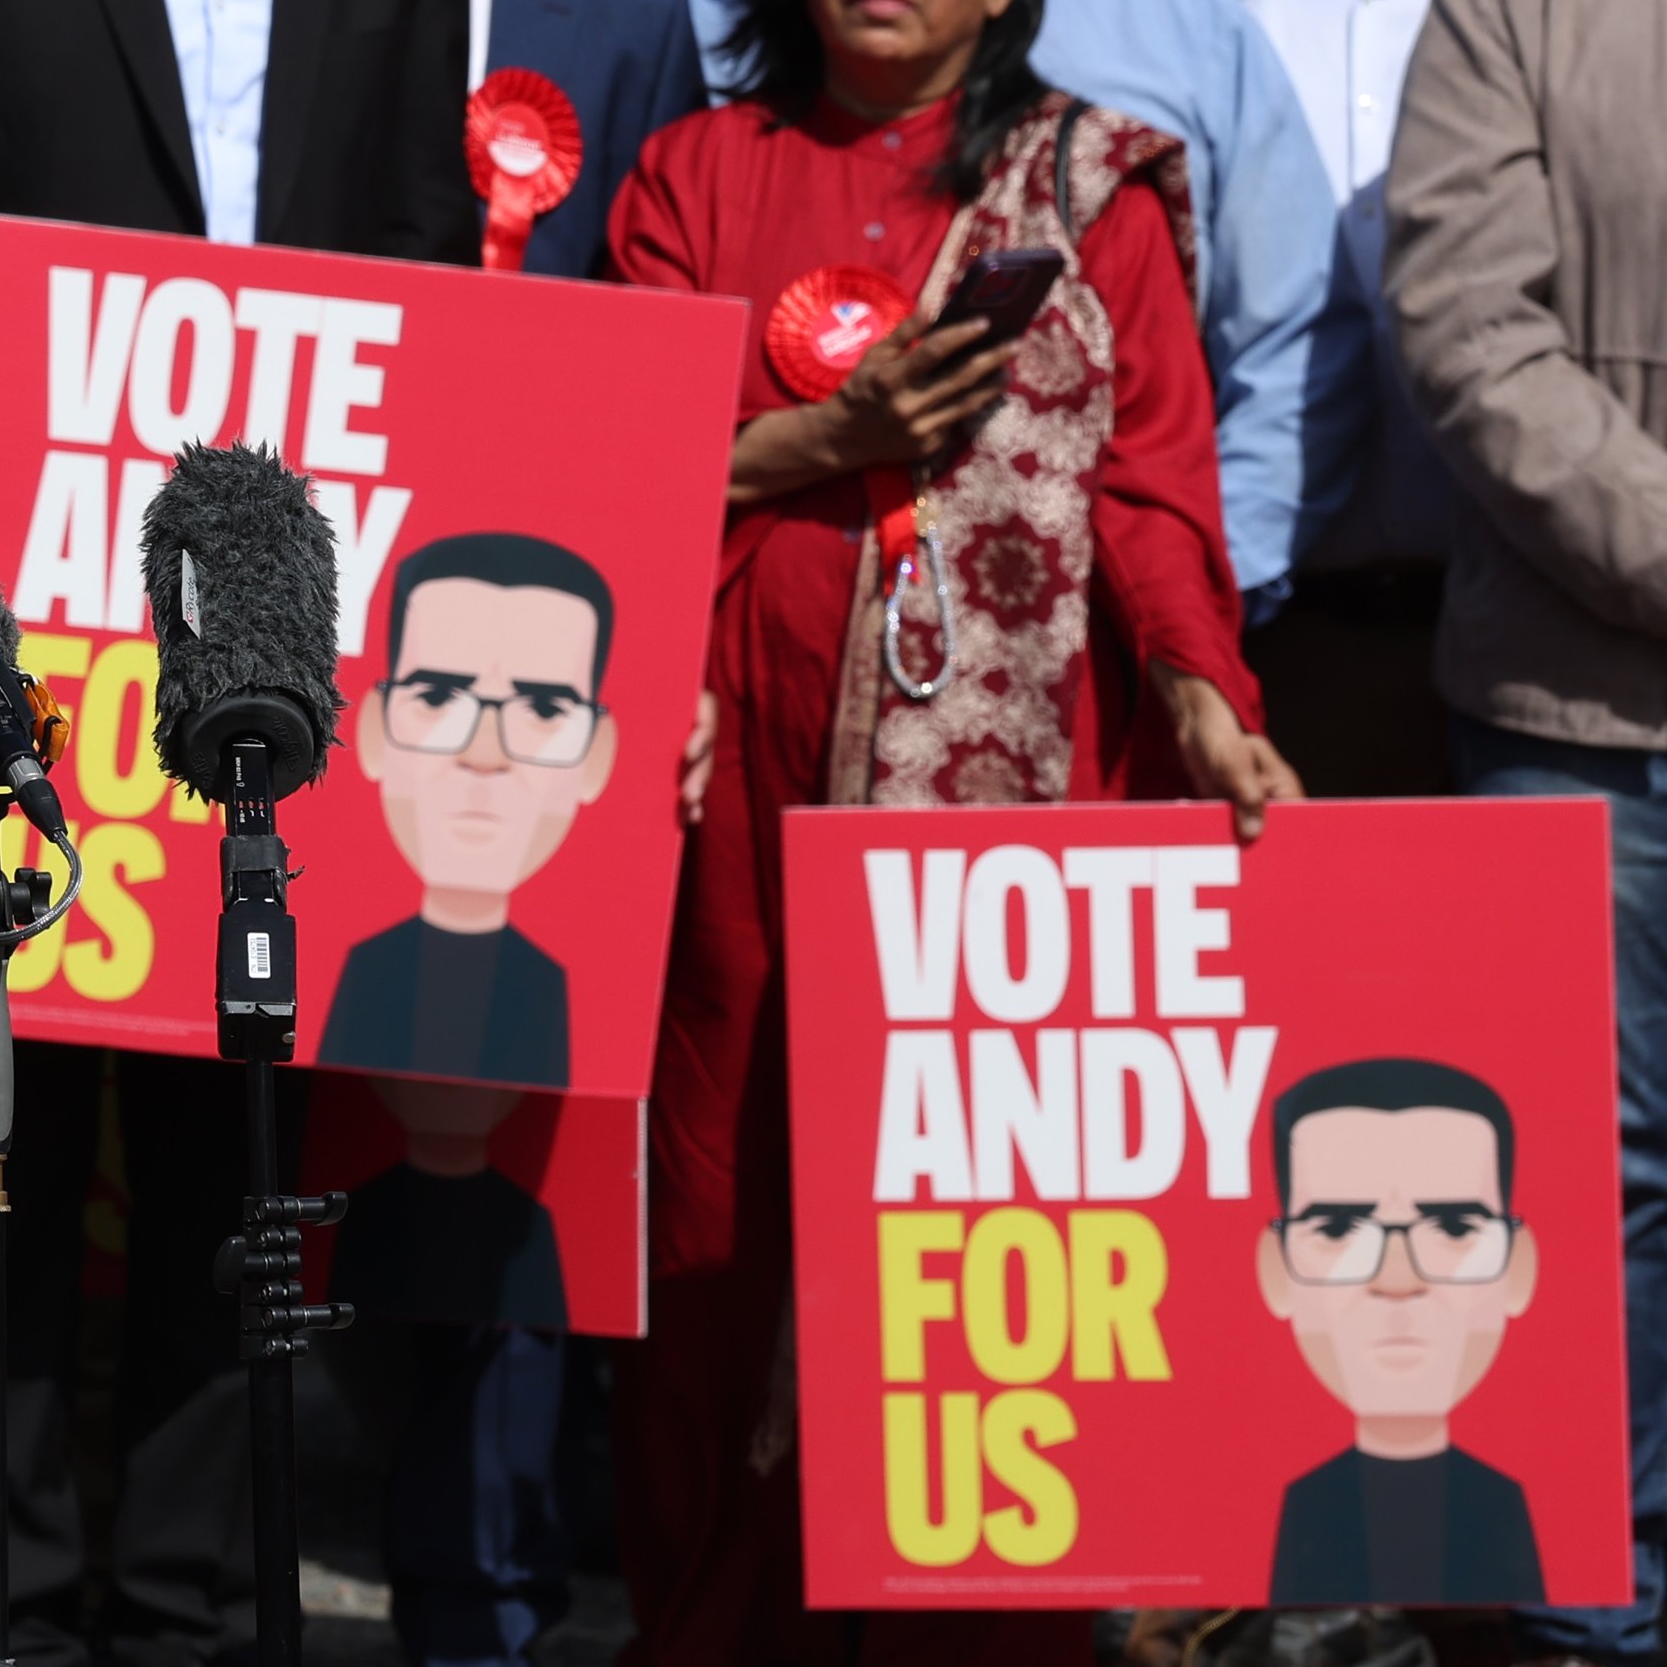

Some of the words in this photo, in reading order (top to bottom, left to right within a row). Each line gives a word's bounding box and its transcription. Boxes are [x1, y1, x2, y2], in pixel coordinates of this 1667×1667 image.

[48, 266, 403, 475] VOTE
[9, 452, 413, 657] AY
[864, 844, 1246, 1023] VOTE
[873, 1027, 1279, 1202] ANDY
[878, 1207, 1172, 1384] FOR
[883, 1389, 1079, 1567] US
